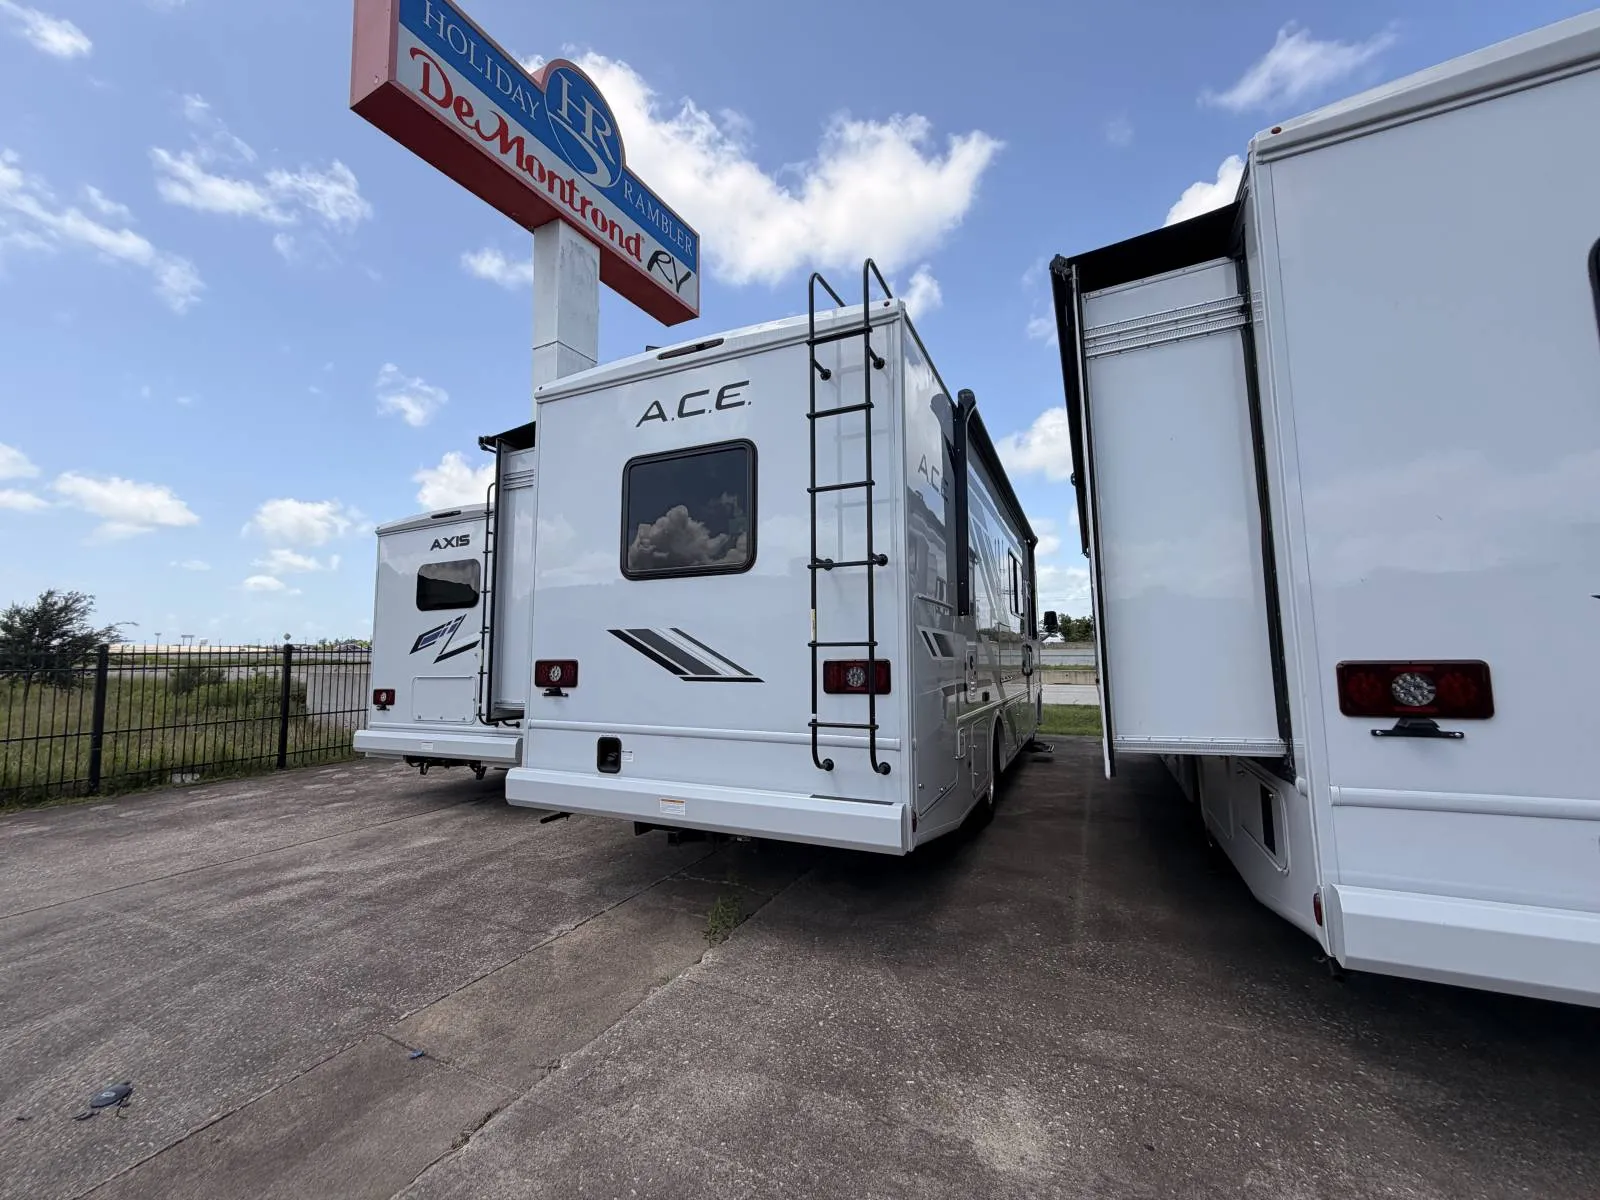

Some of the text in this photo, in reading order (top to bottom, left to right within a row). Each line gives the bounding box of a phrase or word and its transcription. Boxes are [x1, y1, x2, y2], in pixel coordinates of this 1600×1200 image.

[423, 0, 540, 120] HOLIDAY
[557, 71, 616, 165] HR
[409, 47, 692, 294] DeMontrond RV
[623, 179, 693, 257] RAMBLER
[636, 380, 752, 428] A.C.E.
[430, 534, 470, 551] AXIS
